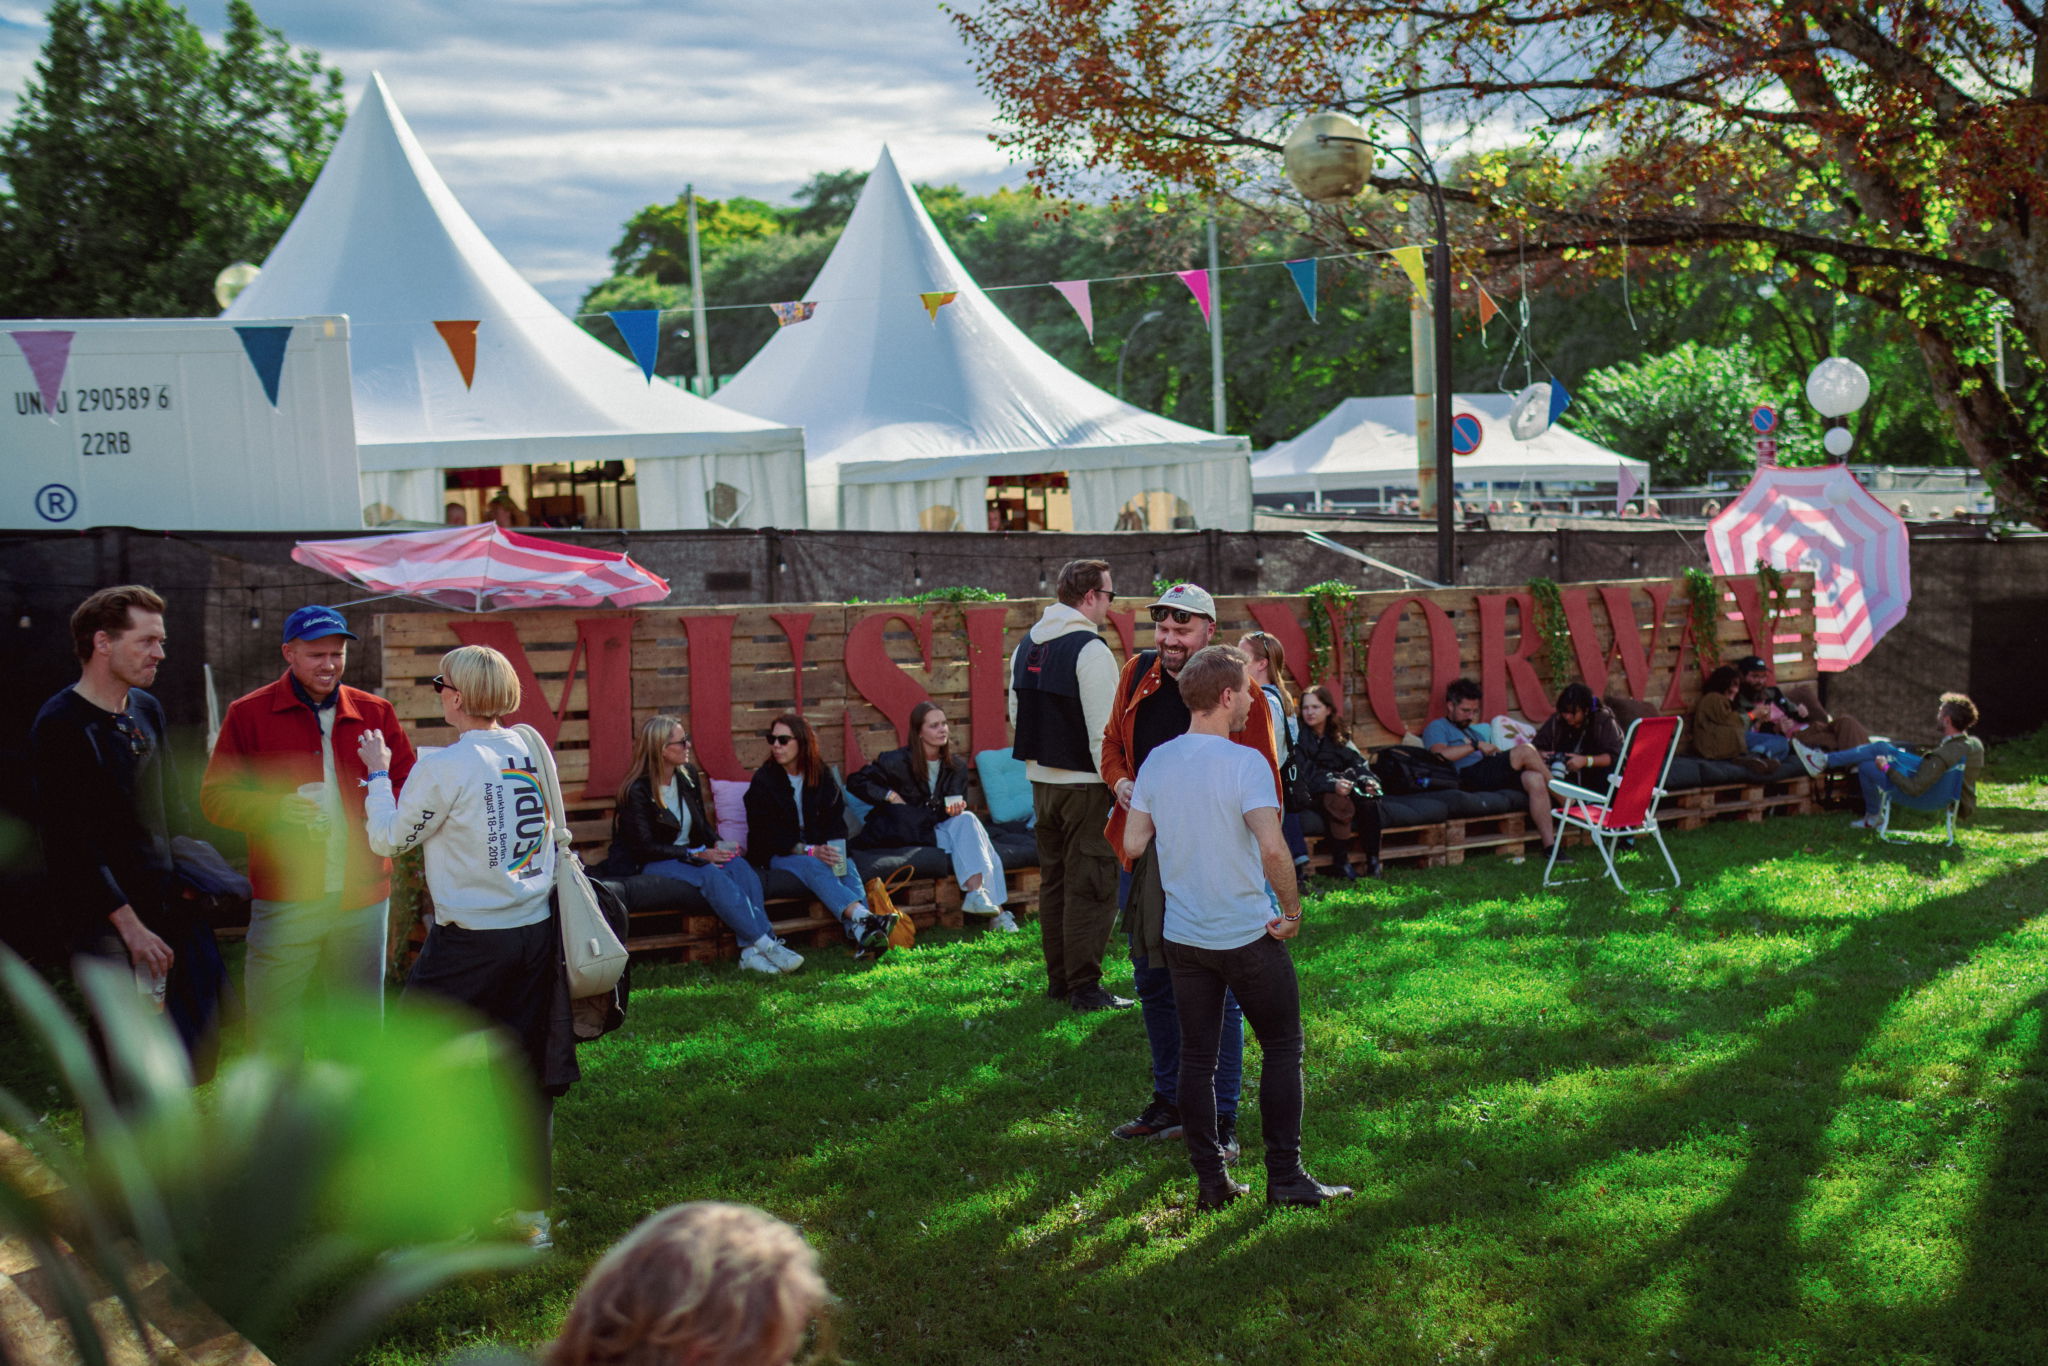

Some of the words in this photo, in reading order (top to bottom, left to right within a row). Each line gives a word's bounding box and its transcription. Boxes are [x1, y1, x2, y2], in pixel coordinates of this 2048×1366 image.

[14, 391, 68, 415] UNU
[77, 387, 150, 412] 290589
[158, 386, 170, 409] 6
[81, 431, 132, 456] 22RB
[449, 607, 1136, 799] MUSI
[484, 782, 496, 815] August
[496, 784, 506, 832] Funkhaus,
[488, 845, 499, 870] 2018.
